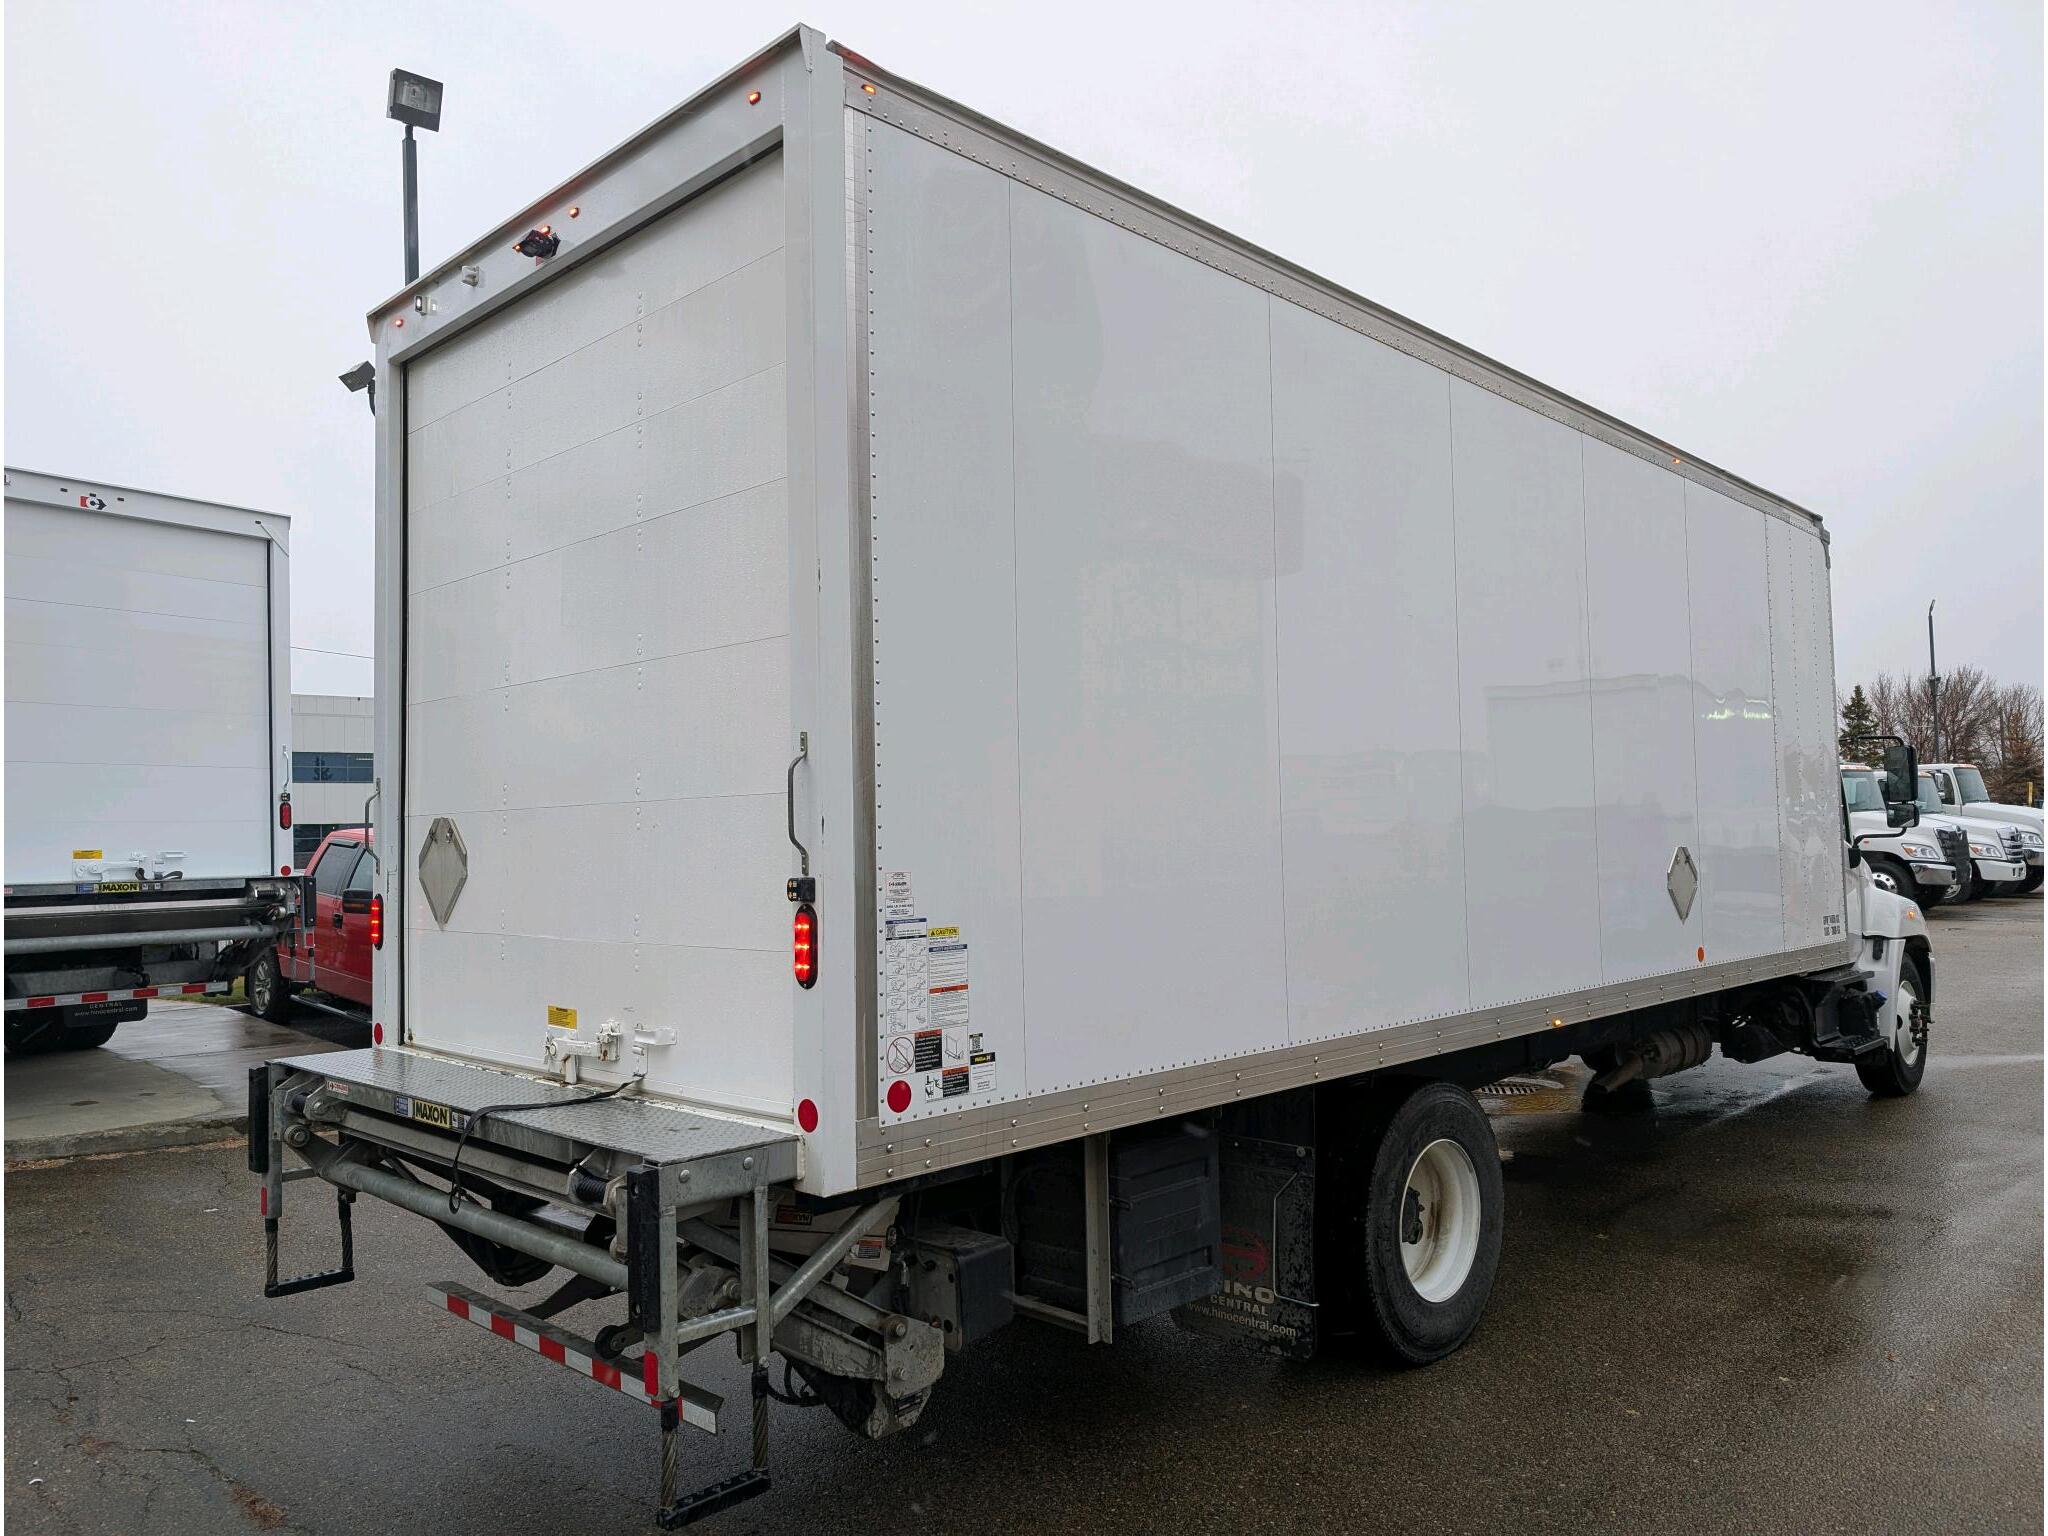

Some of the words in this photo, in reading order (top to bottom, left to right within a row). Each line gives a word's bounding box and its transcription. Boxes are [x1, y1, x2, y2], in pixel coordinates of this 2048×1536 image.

[102, 882, 138, 892] MAXON
[935, 928, 957, 936] CAUTION
[415, 1100, 448, 1125] MAXON
[1221, 1279, 1275, 1304] INO
[1209, 1294, 1269, 1317] CENTRAL
[1186, 1302, 1297, 1337] www.hinocentral.com
